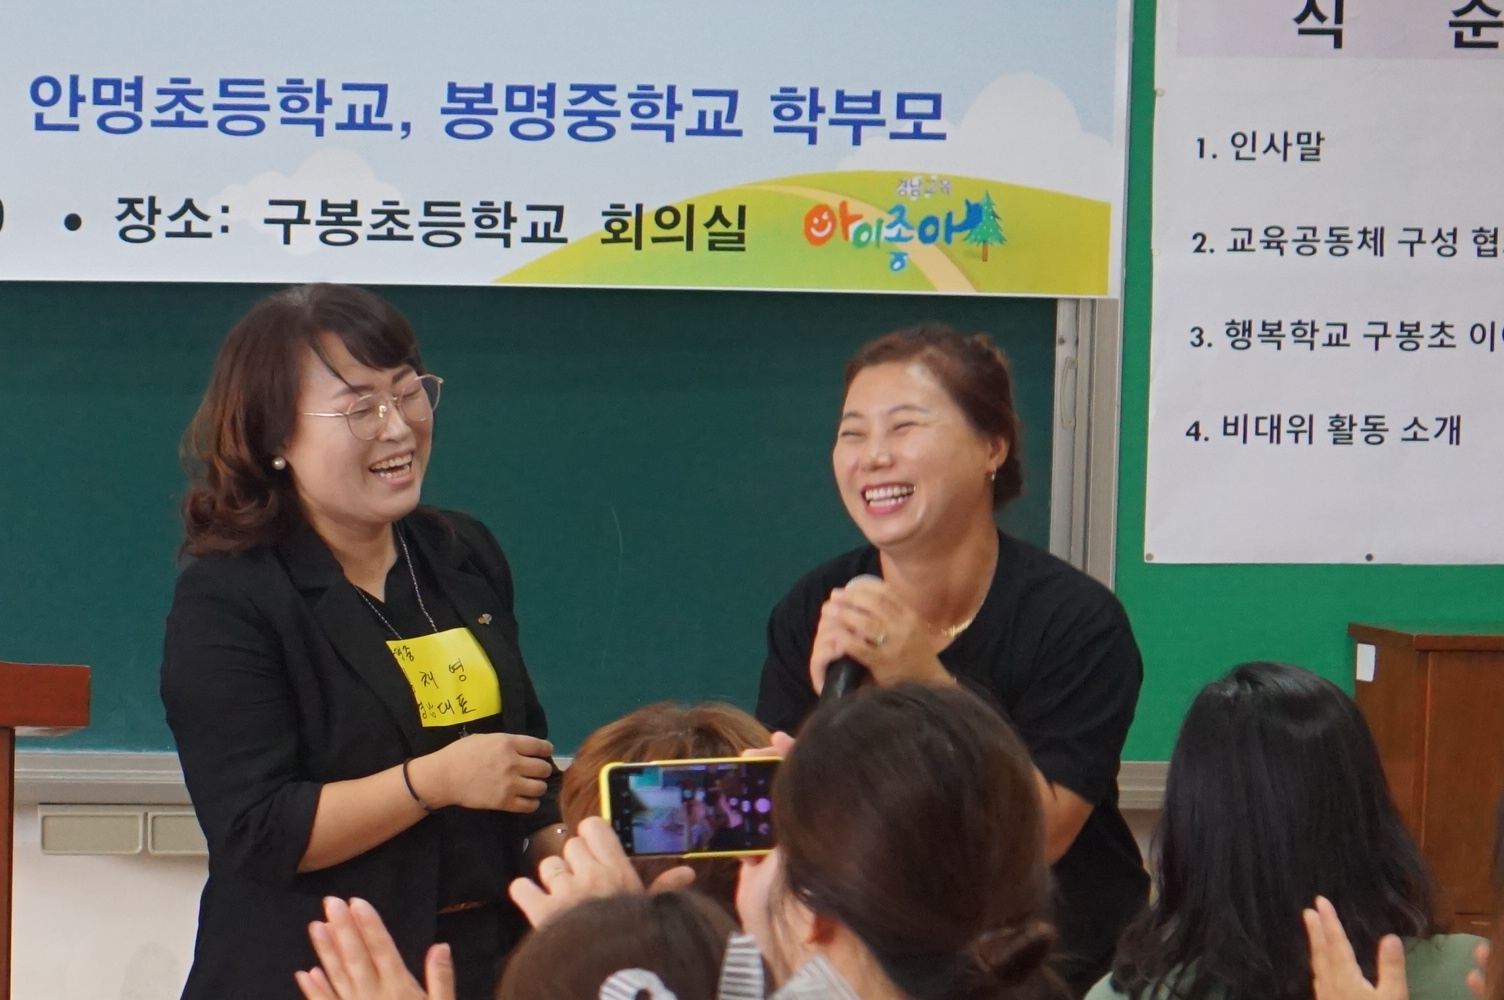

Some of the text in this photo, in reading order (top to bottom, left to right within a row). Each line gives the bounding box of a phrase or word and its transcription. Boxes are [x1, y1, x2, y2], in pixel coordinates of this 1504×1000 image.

[1293, 0, 1504, 49] 식 순
[29, 74, 412, 140] 안명초등학교,
[440, 81, 744, 143] 봉명중학교
[770, 86, 948, 146] 학부모
[1196, 130, 1326, 162] 1. 인사말
[115, 196, 747, 253] 장소: 구봉초등학교 회의실
[1192, 225, 1504, 258] 2. 교육공동체 구성 협
[1190, 319, 1504, 353] 3. 행복학교 구봉초 이
[1185, 413, 1462, 447] 4. 비대위 활동 소개
